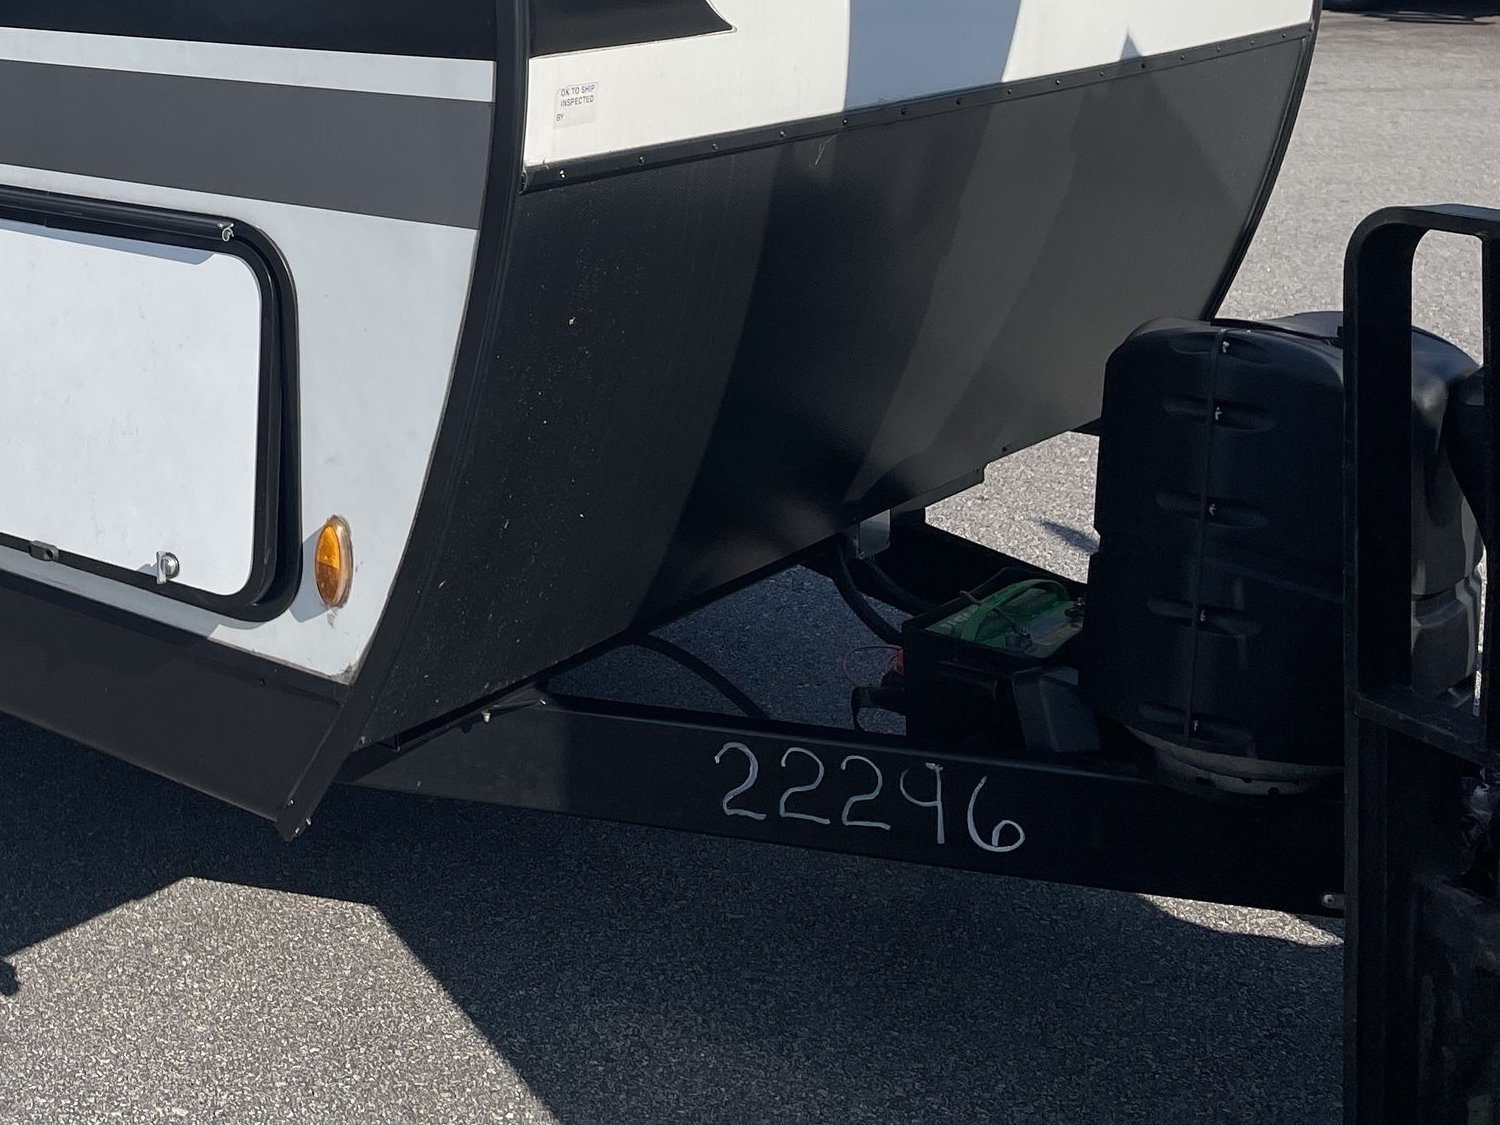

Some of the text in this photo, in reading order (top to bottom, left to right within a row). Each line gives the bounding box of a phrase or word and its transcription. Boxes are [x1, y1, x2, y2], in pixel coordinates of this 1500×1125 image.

[560, 84, 595, 97] OK TO SHIP
[560, 94, 595, 107] INSPECTED
[714, 741, 1026, 853] 22296
